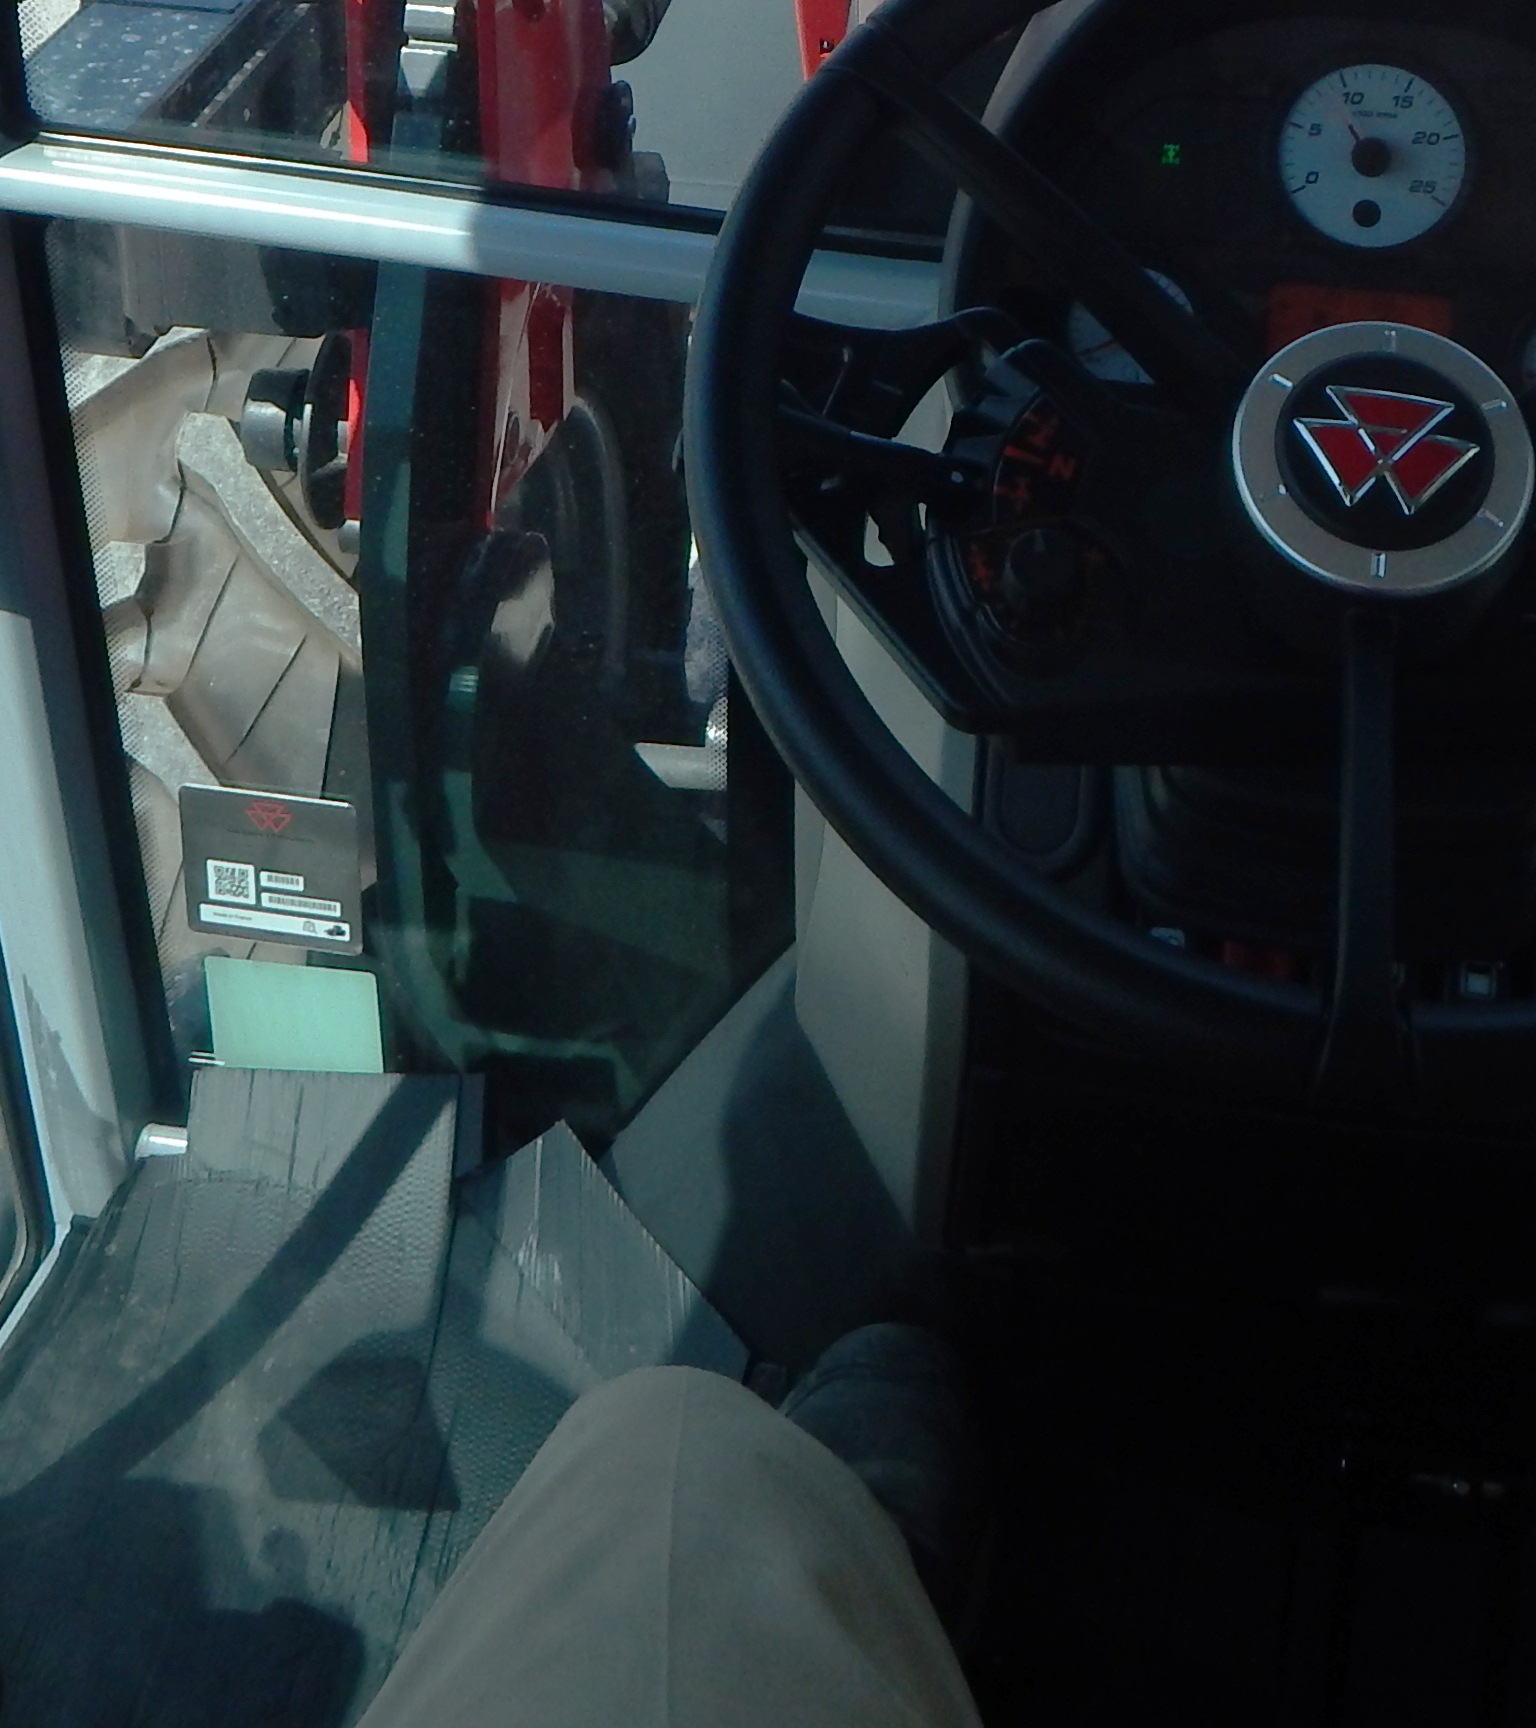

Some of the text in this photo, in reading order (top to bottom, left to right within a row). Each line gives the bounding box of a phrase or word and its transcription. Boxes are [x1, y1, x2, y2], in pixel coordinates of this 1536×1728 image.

[1342, 91, 1365, 105] 10
[1392, 95, 1414, 109] 15
[1308, 123, 1322, 136] 5
[1411, 131, 1440, 145] 20
[1305, 171, 1319, 184] 0
[1409, 180, 1437, 194] 25
